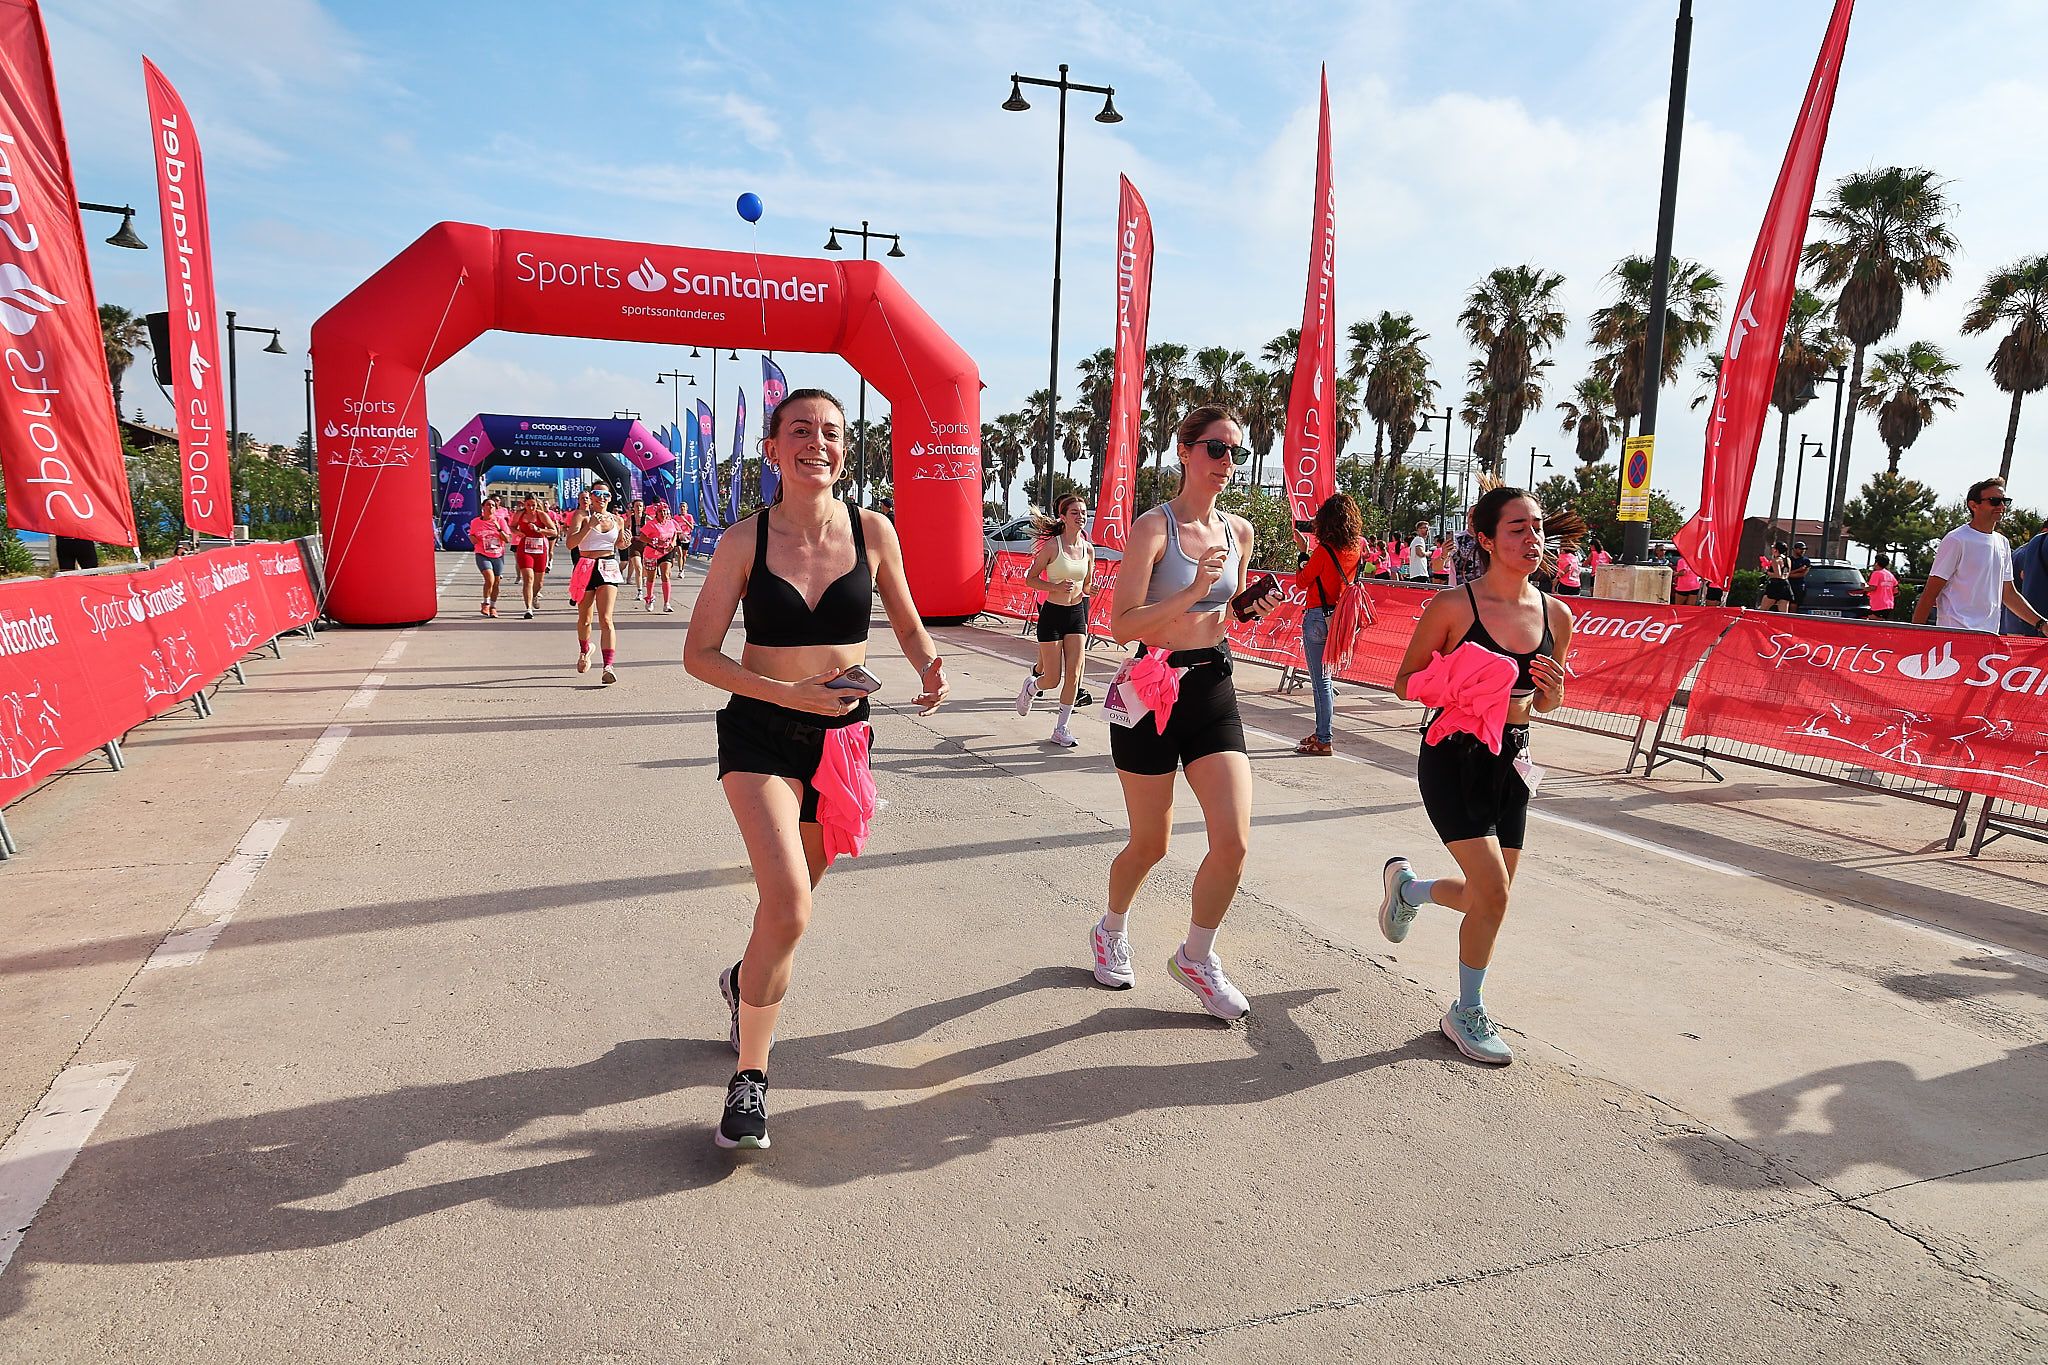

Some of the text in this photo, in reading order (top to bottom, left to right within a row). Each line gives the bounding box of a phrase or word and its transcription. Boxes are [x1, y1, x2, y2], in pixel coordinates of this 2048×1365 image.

[516, 252, 829, 303] Sports Santander
[621, 305, 726, 321] sportssantander.es
[343, 398, 396, 416] Sports
[340, 424, 418, 438] Santander
[930, 421, 969, 436] Sports
[501, 449, 583, 459] VOLVO
[927, 443, 980, 456] Santande
[1093, 569, 1117, 589] Sport
[80, 595, 132, 642] Sports
[1571, 610, 1684, 645] tander
[1757, 633, 1894, 674] Sports
